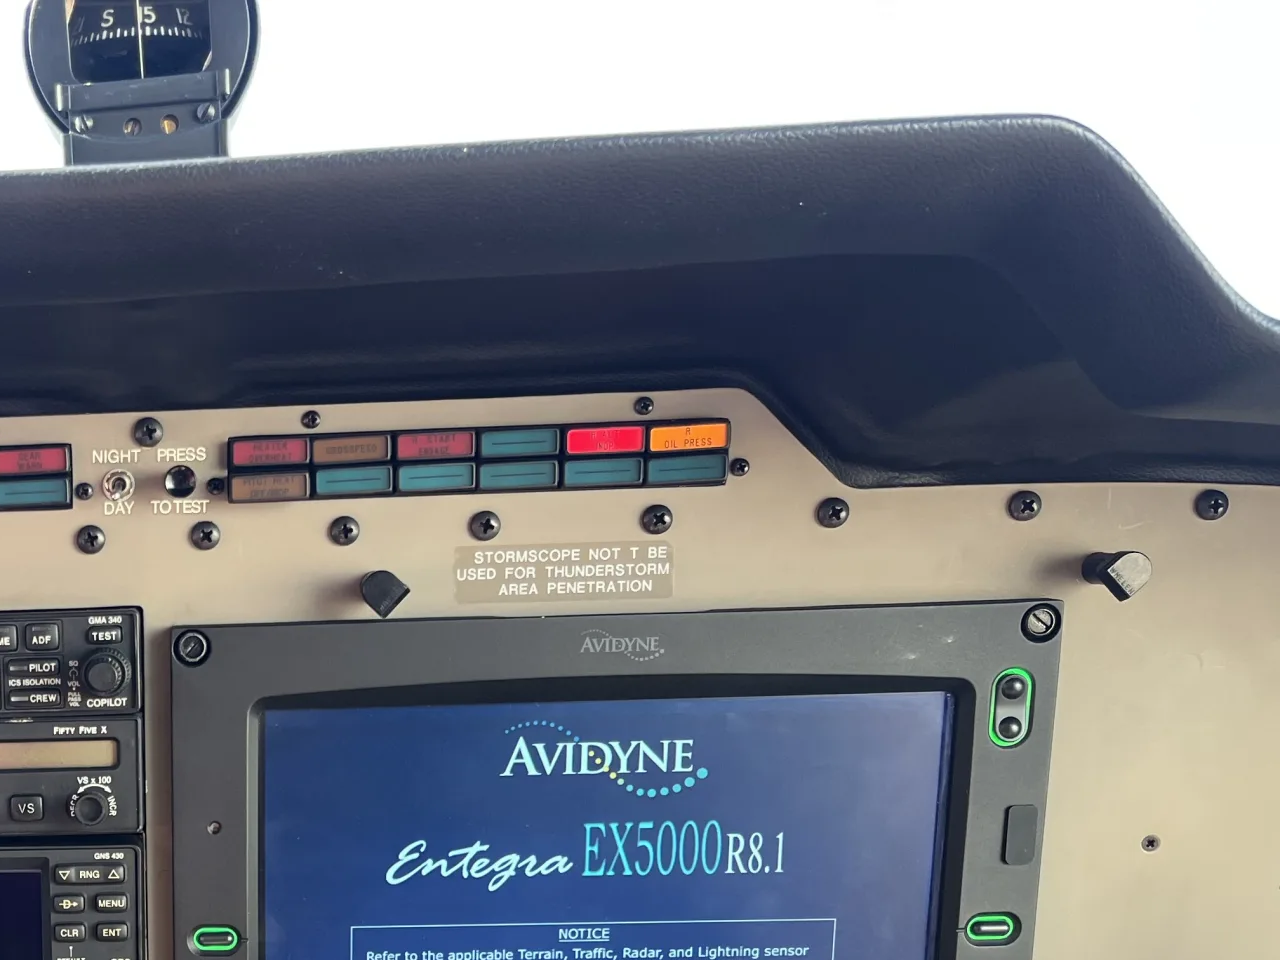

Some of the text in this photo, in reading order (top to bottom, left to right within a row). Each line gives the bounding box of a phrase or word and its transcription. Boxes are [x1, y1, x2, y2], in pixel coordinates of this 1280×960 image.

[101, 9, 114, 27] S
[664, 438, 713, 449] OIL PRESS
[93, 449, 141, 463] NIGHT
[158, 447, 206, 462] PRESS
[104, 499, 134, 515] DAY
[173, 500, 209, 516] TEST
[474, 549, 580, 564] STORMSCOPE
[589, 548, 621, 560] NOT
[648, 547, 667, 558] BE
[457, 562, 669, 581] USED FOR THUNDERSTORM
[499, 580, 652, 595] AREA PENETRATION
[32, 635, 51, 644] ADF
[92, 631, 117, 640] TEST
[581, 634, 660, 654] AVIDYNE
[29, 663, 56, 672] PILOT
[30, 694, 56, 702] CREW
[87, 698, 127, 707] COPILOT
[500, 736, 693, 778] AVIDYNE
[19, 803, 34, 814] VS
[386, 840, 573, 891] Entegra
[80, 870, 99, 878] RNG
[99, 898, 125, 907] MENU
[61, 929, 78, 937] CLR
[103, 927, 122, 936] ENT
[559, 928, 609, 940] NOTICE
[405, 952, 417, 960] to
[422, 951, 443, 960] the
[518, 949, 567, 960] Terrain,
[572, 948, 617, 960] Traffic,
[623, 947, 663, 960] Radar,
[669, 947, 692, 957] and
[699, 946, 759, 959] Lightning
[765, 947, 809, 956] sensor
